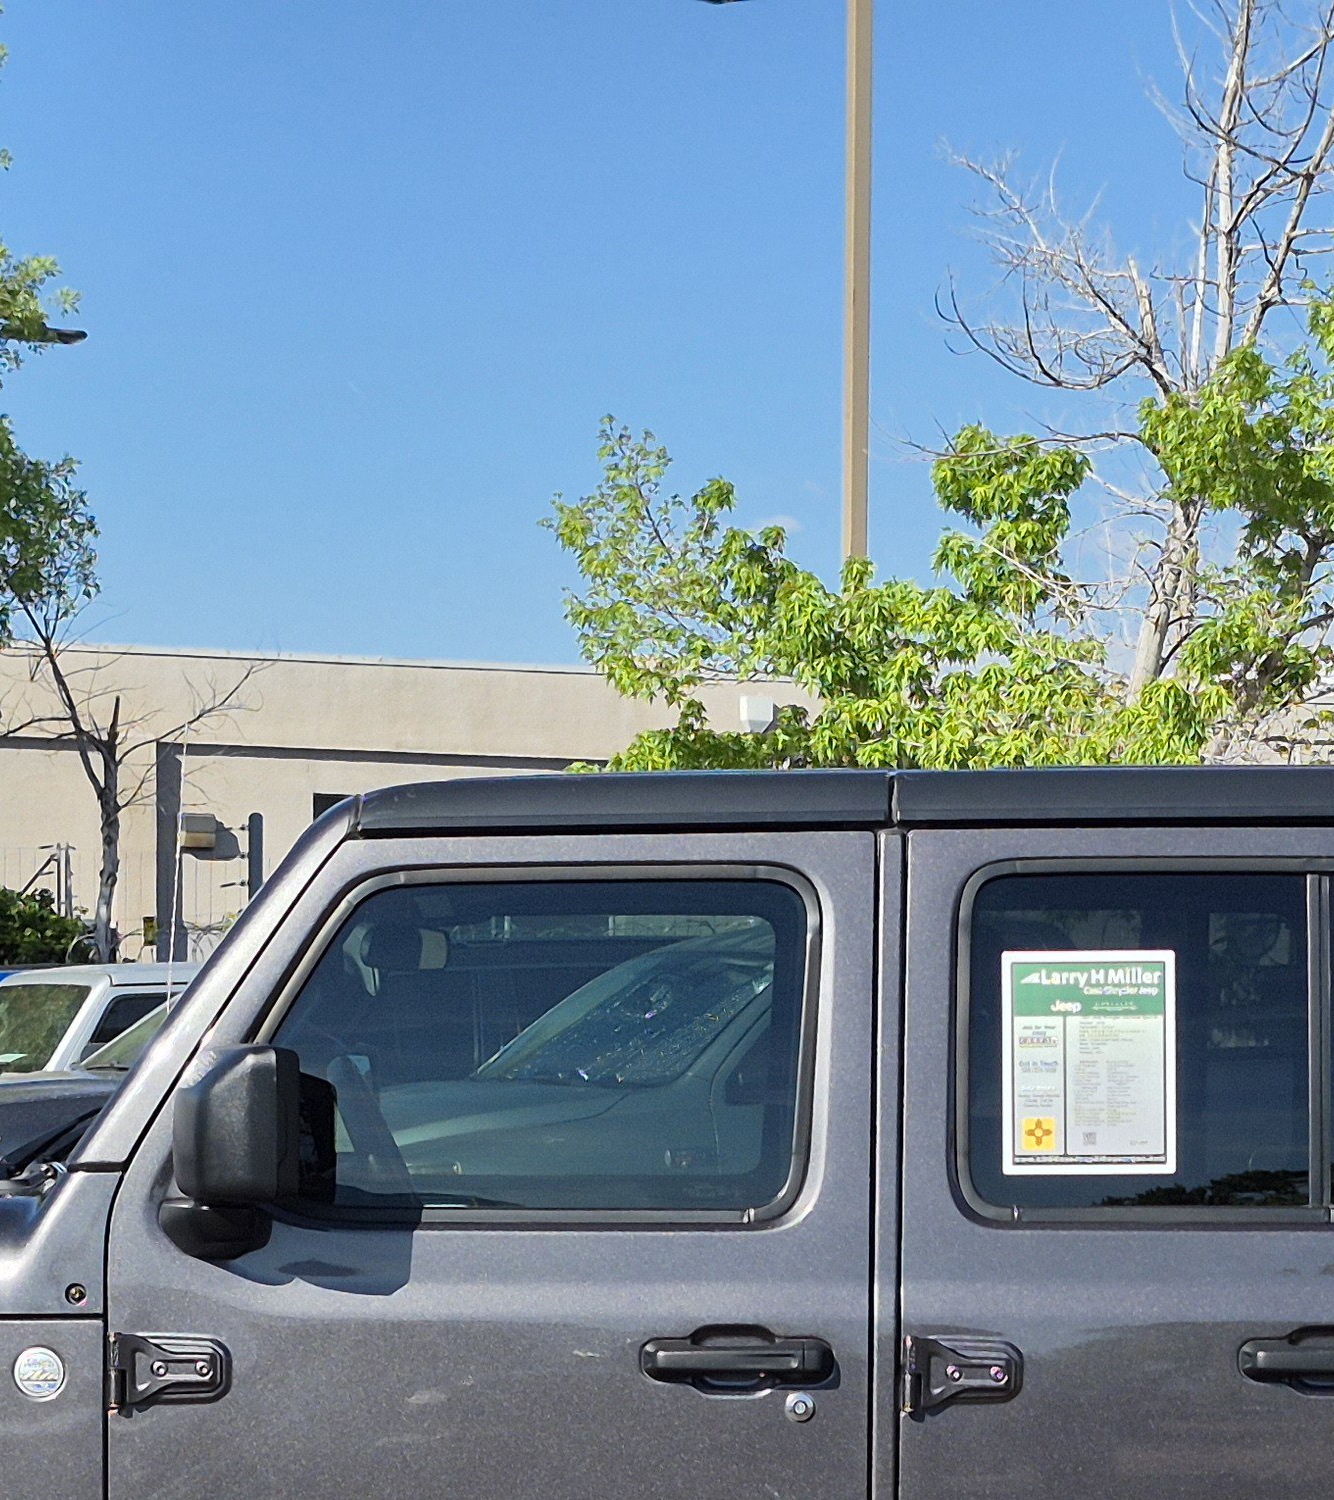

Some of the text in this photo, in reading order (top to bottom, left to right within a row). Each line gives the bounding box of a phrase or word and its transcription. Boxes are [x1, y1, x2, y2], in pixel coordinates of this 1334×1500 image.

[1041, 966, 1162, 988] Larry H Miller
[1050, 998, 1082, 1013] Jeep
